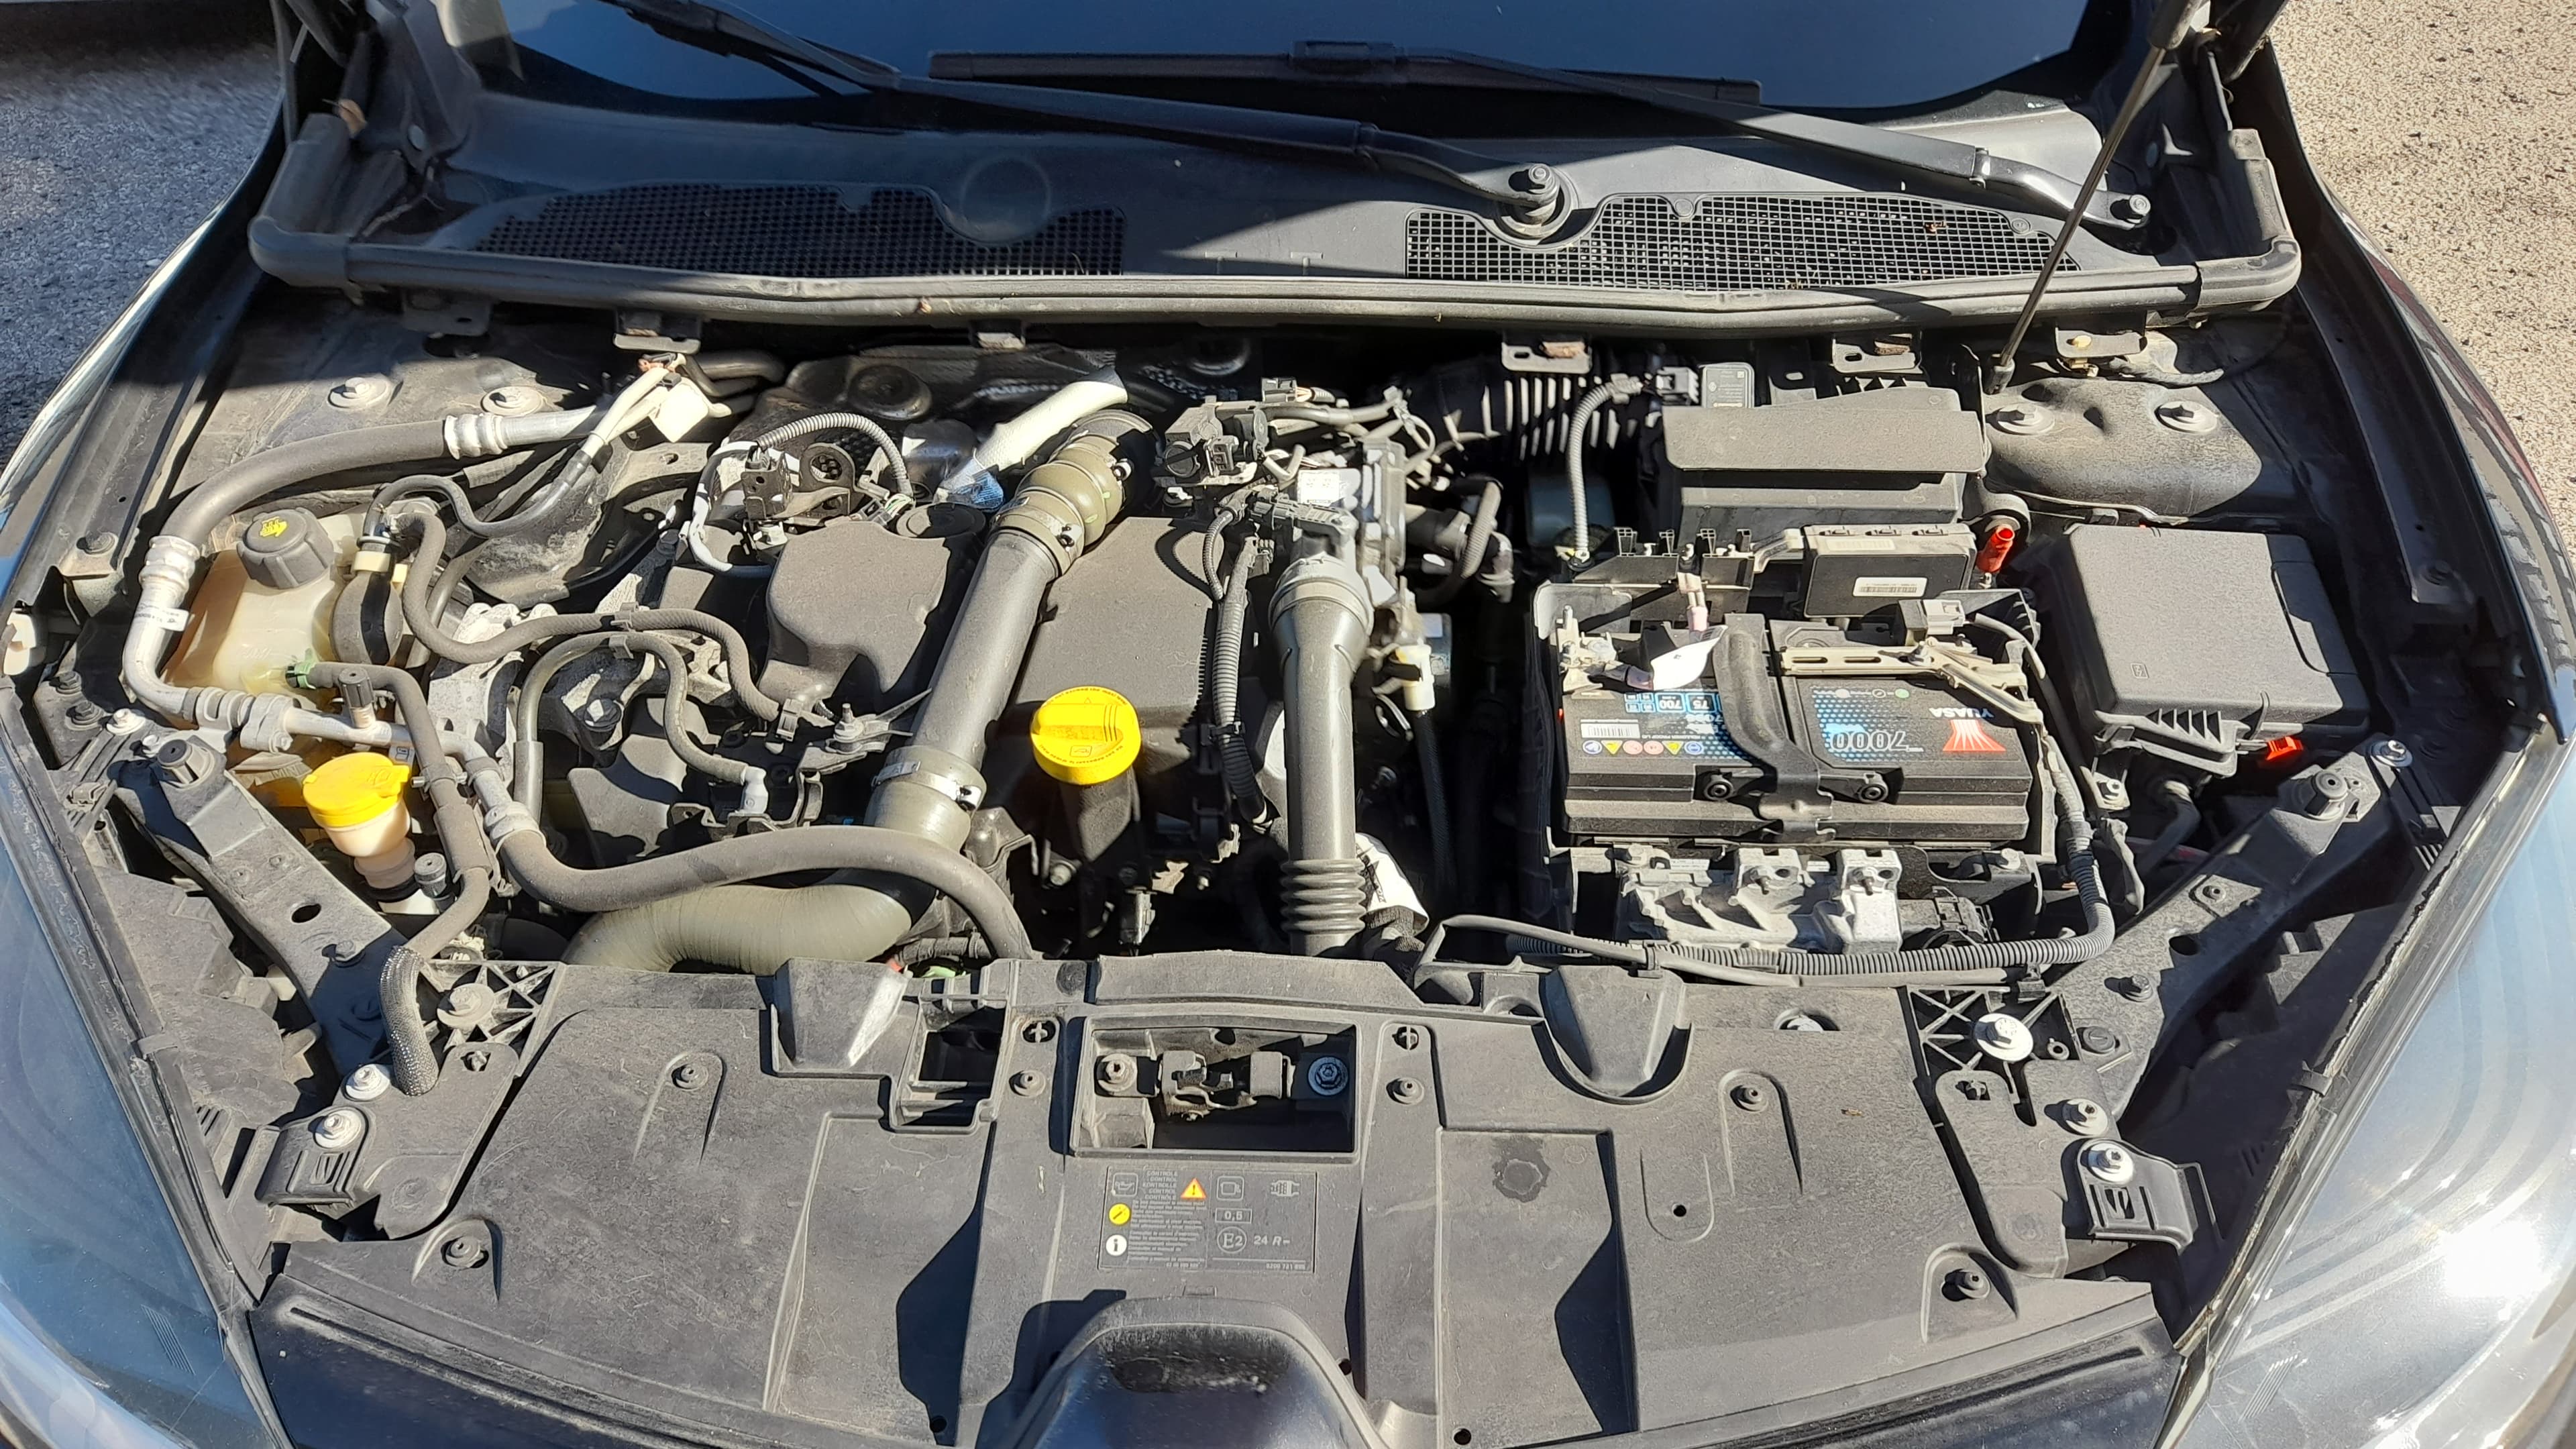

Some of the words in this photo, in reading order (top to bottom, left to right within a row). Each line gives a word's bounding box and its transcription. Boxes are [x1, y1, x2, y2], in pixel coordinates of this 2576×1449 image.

[1659, 699, 1682, 708] 700
[1693, 700, 1709, 709] 75
[1928, 707, 1994, 718] YUASA
[1831, 731, 1907, 750] 7000
[1222, 1233, 1243, 1248] E2
[1254, 1235, 1268, 1245] 24
